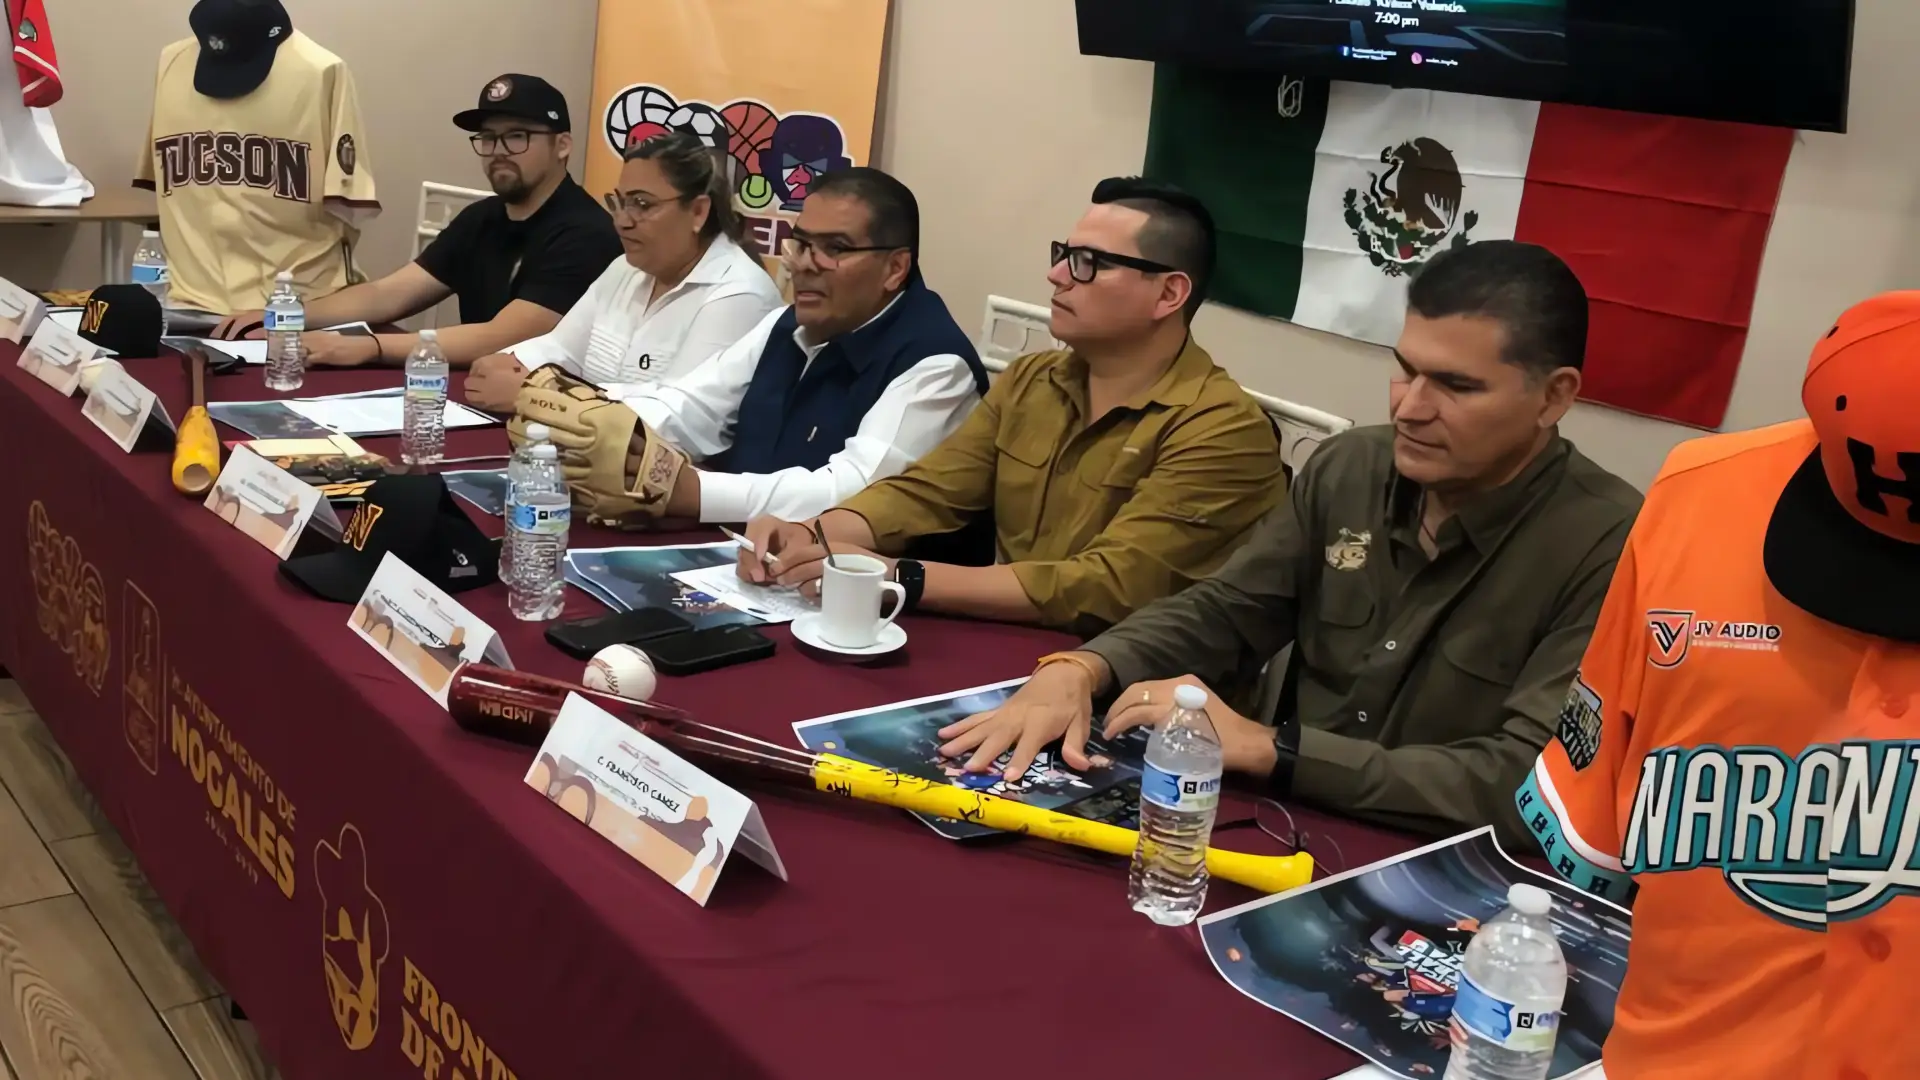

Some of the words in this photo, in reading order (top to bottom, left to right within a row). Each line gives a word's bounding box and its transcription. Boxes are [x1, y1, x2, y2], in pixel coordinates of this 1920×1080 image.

[1375, 11, 1400, 25] 7:00
[1401, 17, 1419, 28] pm
[155, 131, 311, 203] TUCSON
[1846, 436, 1920, 524] H
[1718, 621, 1782, 641] AUDIO
[172, 703, 295, 900] NOGALES
[403, 955, 519, 1080] FRONT
